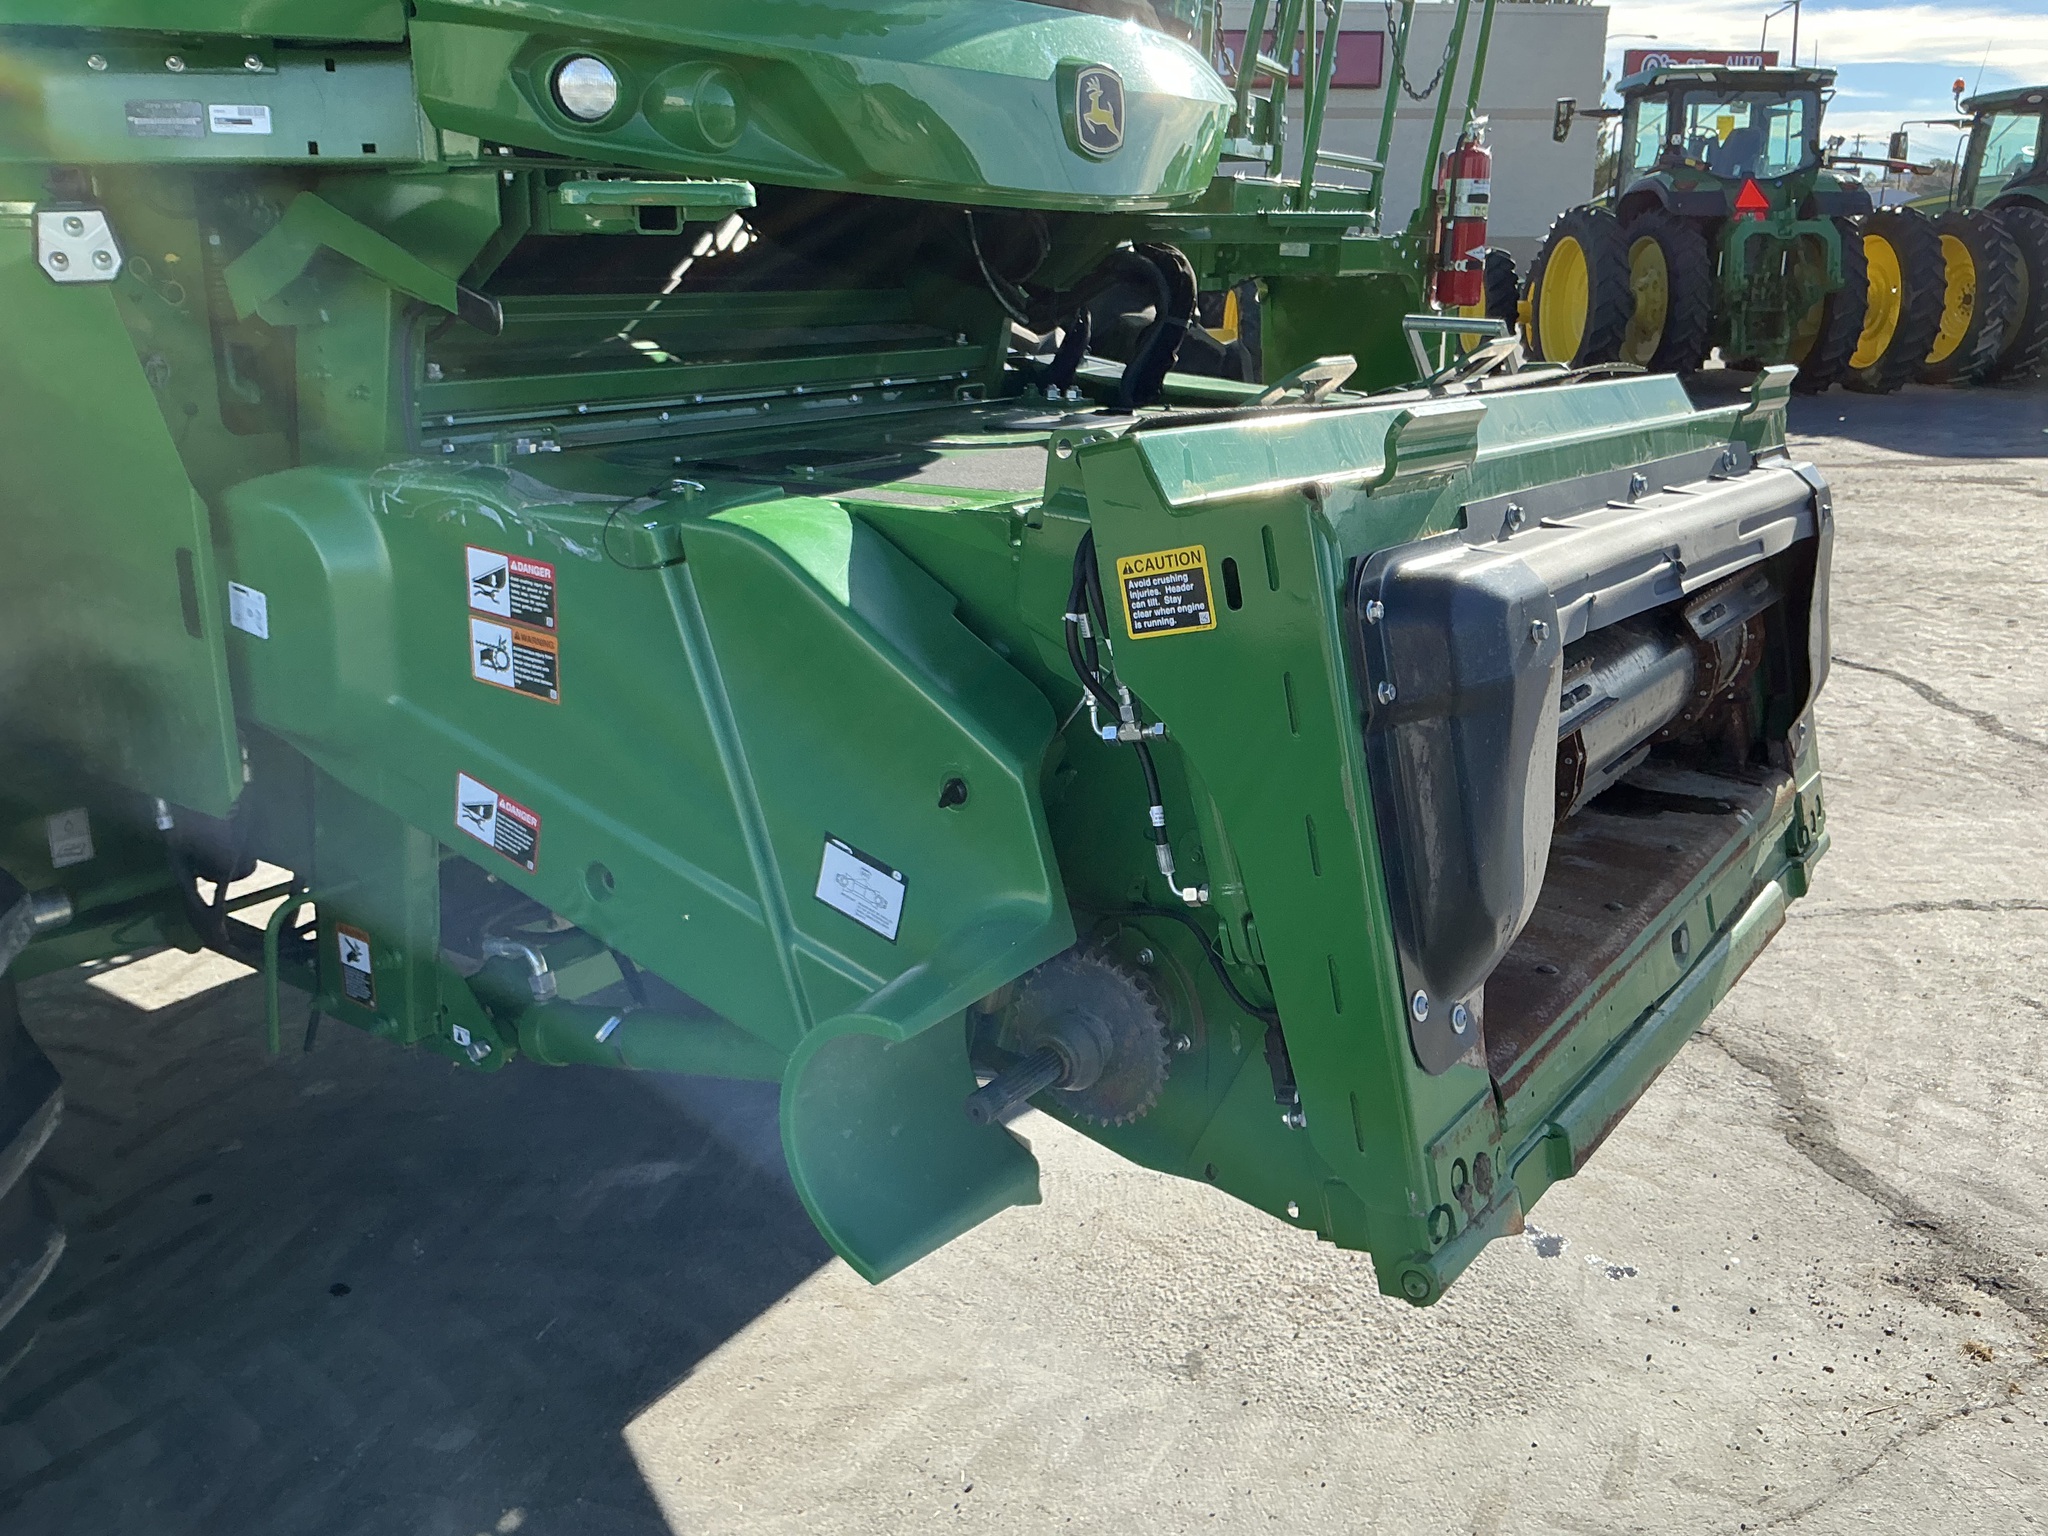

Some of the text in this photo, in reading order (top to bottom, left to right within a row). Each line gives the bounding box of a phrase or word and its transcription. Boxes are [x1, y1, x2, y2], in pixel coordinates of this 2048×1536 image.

[1726, 55, 1763, 67] AUTO
[517, 561, 552, 578] DANGER
[1134, 550, 1201, 573] CAUTION
[1128, 574, 1188, 589] Avoid crushing
[1129, 583, 1194, 600] injuries. Header
[1131, 595, 1182, 609] can tilt. Stay
[1133, 602, 1205, 619] clear when engine
[1134, 617, 1177, 629] is running.
[520, 633, 556, 650] WARNING
[505, 802, 538, 828] DANGER
